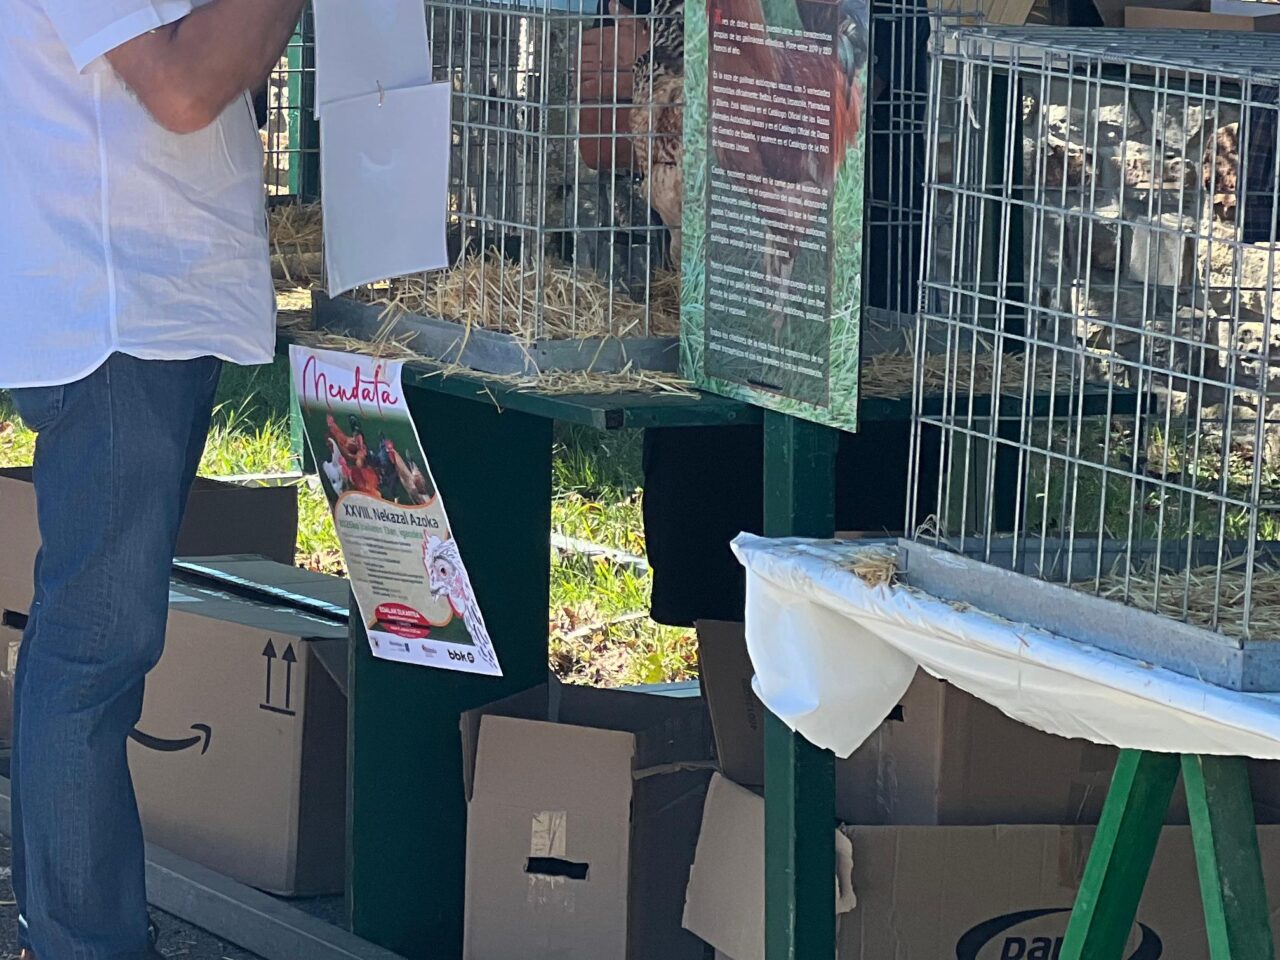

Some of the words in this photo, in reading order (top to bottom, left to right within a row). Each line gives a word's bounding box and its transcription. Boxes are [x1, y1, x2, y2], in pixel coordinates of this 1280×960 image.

[303, 355, 398, 417] Mendata
[342, 503, 373, 520] XXVIII.
[410, 513, 439, 529] Azoka
[447, 649, 468, 662] bbk
[1000, 936, 1064, 960] pa
